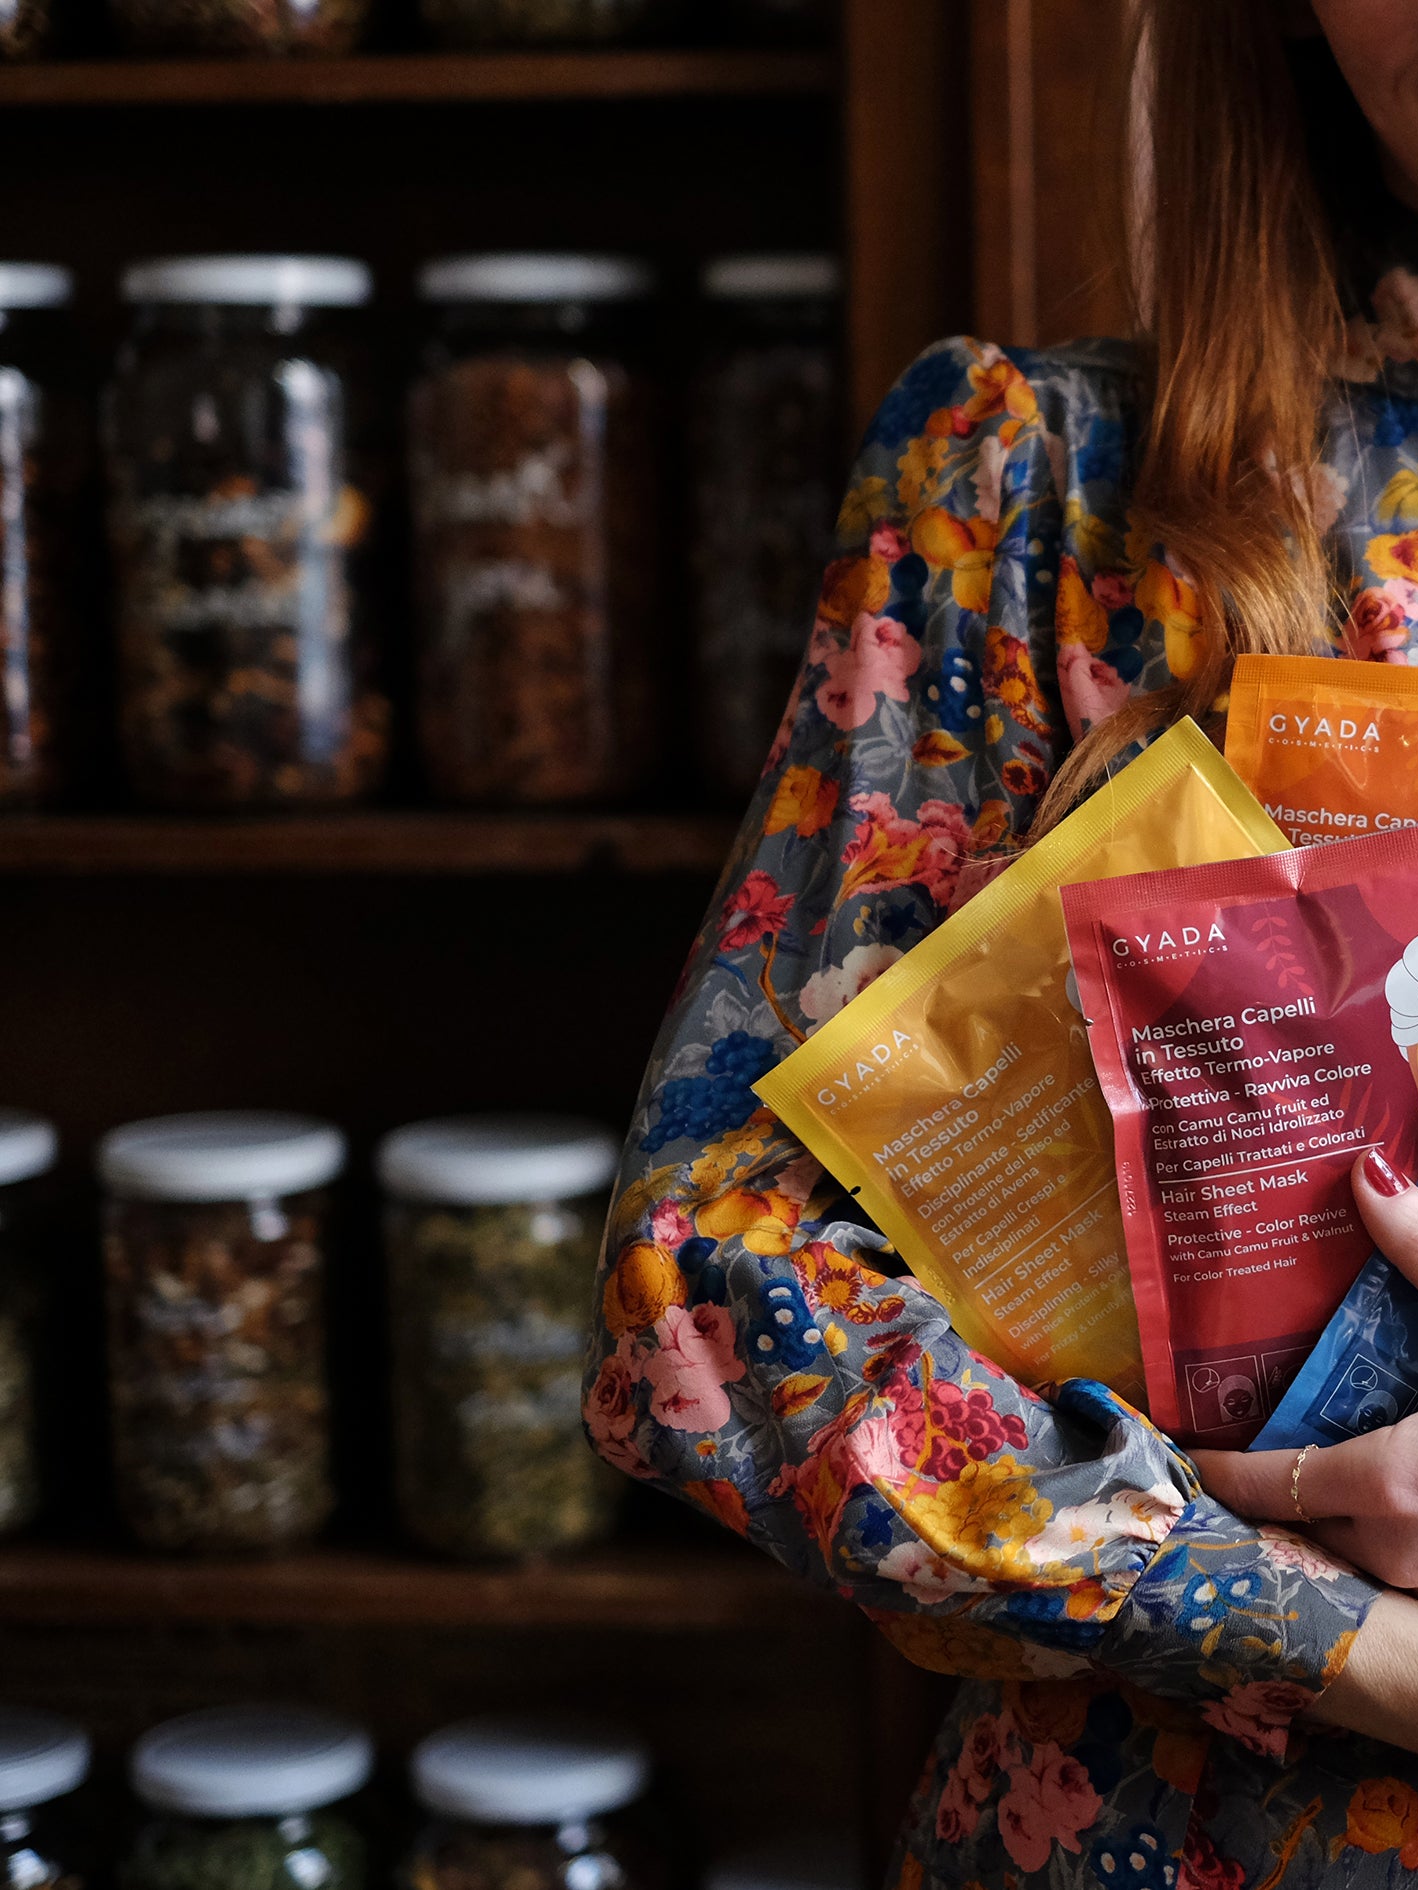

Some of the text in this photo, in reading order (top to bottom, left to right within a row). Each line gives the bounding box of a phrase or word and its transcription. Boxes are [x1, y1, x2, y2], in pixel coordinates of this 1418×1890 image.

[1269, 714, 1380, 741] GYADA
[1265, 803, 1368, 829] Maschera
[1112, 923, 1226, 956] GYADA
[1131, 996, 1316, 1044] Maschera Capelli
[817, 1029, 911, 1105] GYADA
[1134, 1036, 1244, 1065] in Tessuto
[1140, 1043, 1335, 1085] Effetto Termo-Vapore
[872, 1041, 1022, 1165] Maschera Capelli
[1148, 1088, 1230, 1110] Protettiva
[1244, 1074, 1310, 1097] Ravviva
[1313, 1063, 1372, 1083] Colore
[900, 1074, 1055, 1198] Effetto Termo-Vapore
[1151, 1092, 1330, 1134] con Camu Camu fruit ed
[1153, 1109, 1345, 1150] Estratto di Noci Idrolizzato
[884, 1109, 979, 1182] in Tessuto
[916, 1146, 1008, 1220] Disciplinante
[1015, 1077, 1095, 1143] Setificante
[1155, 1125, 1365, 1174] Per Capelli Trattati e Colorati
[931, 1118, 1071, 1233] con Proteine del Riso ed
[1161, 1168, 1308, 1204] Hair Sheet Mask
[938, 1166, 1040, 1246] Estratto di Avena
[951, 1174, 1067, 1265] Per Capelli Crespi e
[1163, 1200, 1258, 1223] Steam Effect
[1167, 1228, 1242, 1246] Protective
[1255, 1218, 1295, 1234] Color
[1298, 1208, 1346, 1227] Revive
[962, 1214, 1041, 1280] Indisciplinati
[980, 1276, 1014, 1305] Hair
[1014, 1242, 1062, 1280] Sheet
[1058, 1208, 1103, 1246] Mask
[1169, 1223, 1354, 1261] with Camu Camu Fruit & Walnut
[993, 1257, 1073, 1320] Steam Effect
[1172, 1255, 1297, 1283] For Color Treated Hair
[1007, 1280, 1083, 1338] Disciplining
[1087, 1250, 1119, 1278] Silky
